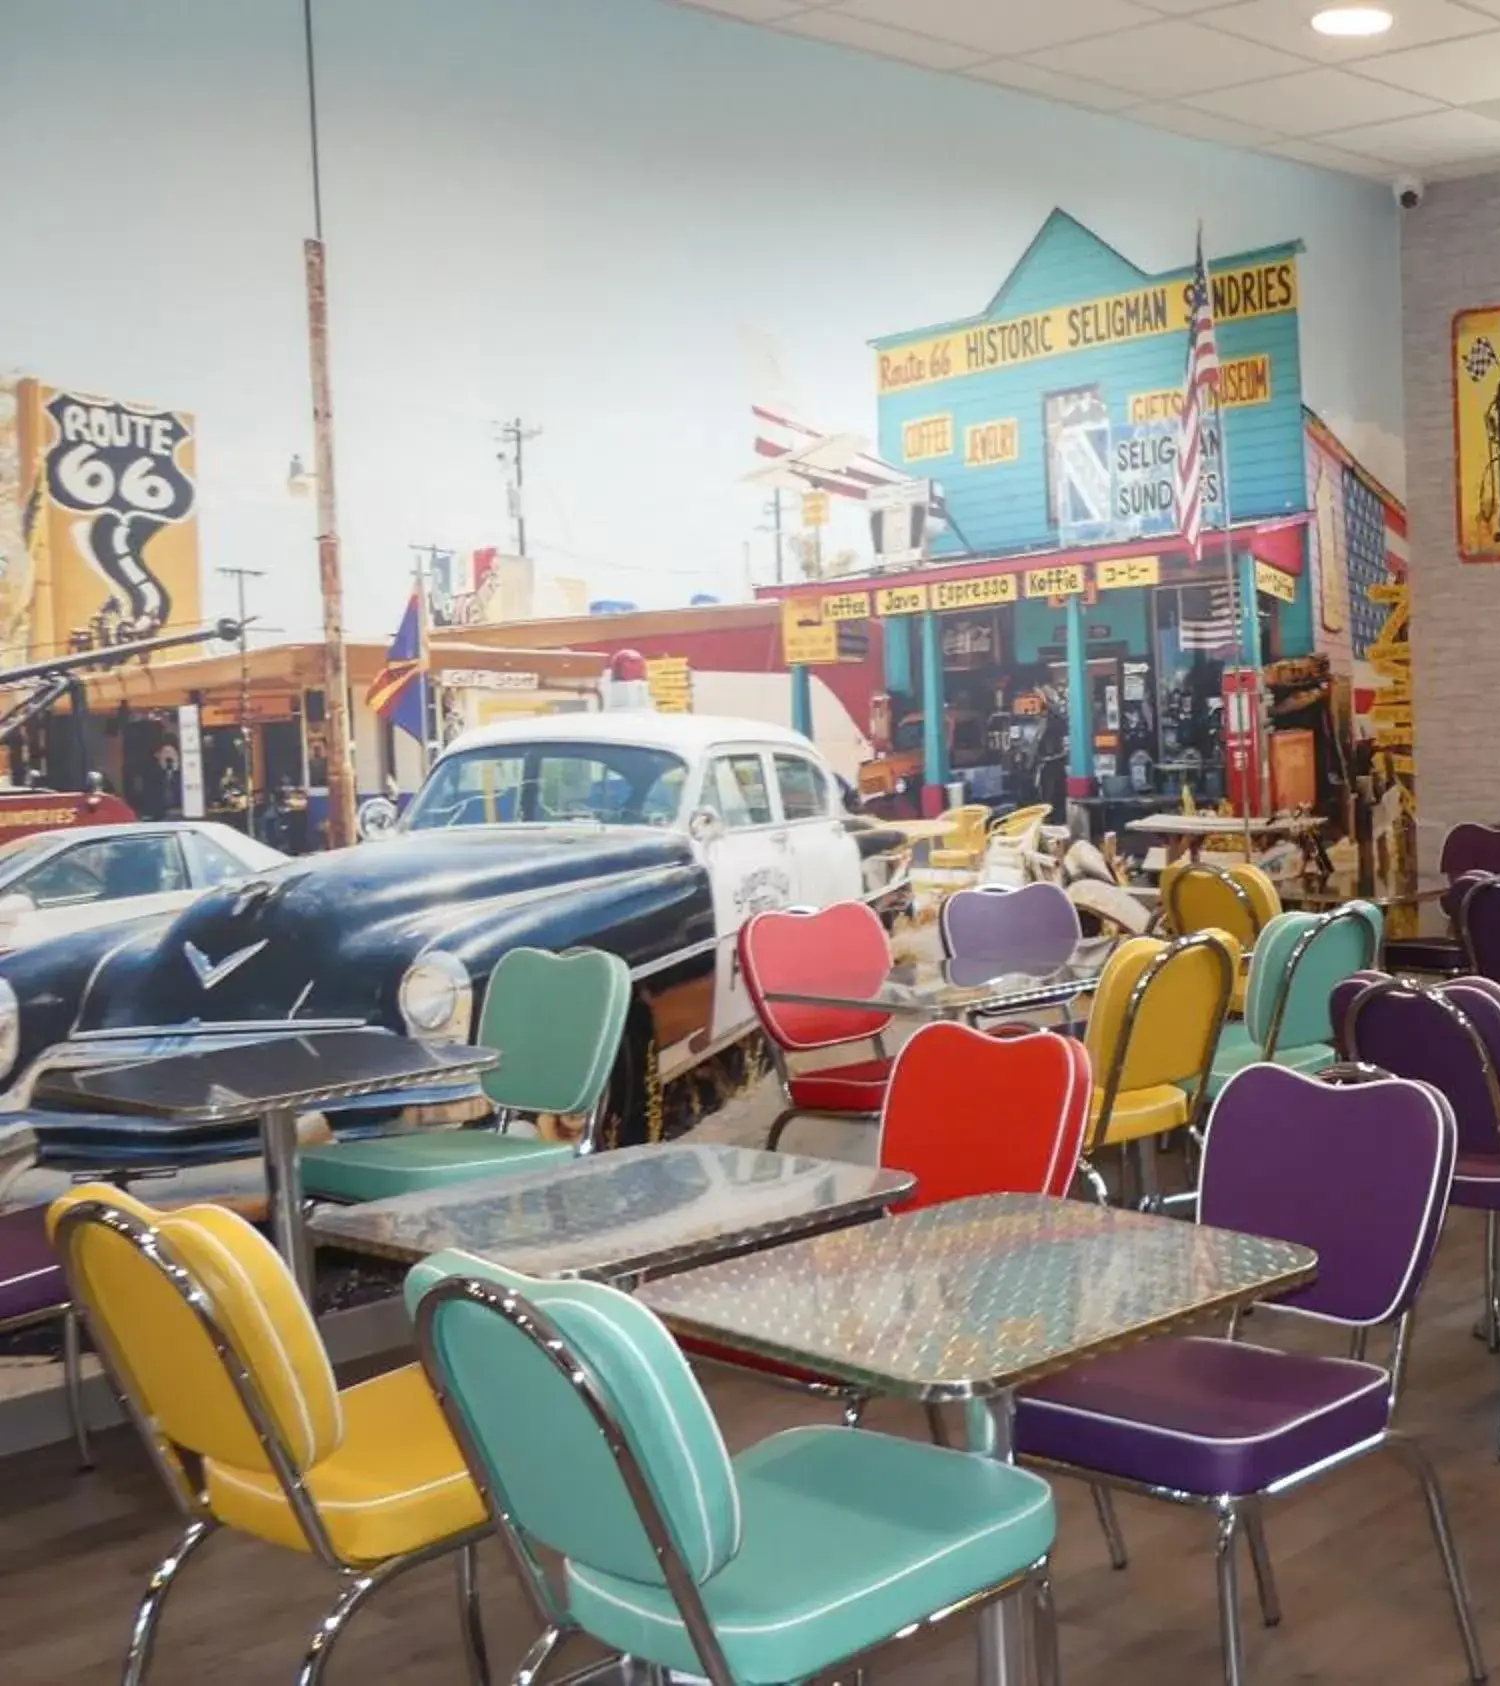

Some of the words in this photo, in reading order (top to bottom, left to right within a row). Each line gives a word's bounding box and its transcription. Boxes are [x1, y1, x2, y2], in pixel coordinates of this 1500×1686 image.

[929, 341, 951, 379] 66
[965, 315, 1053, 370] HISTORIC
[1067, 286, 1168, 348] SELIGMAN
[1183, 264, 1292, 324] SNDRIES
[62, 404, 173, 456] ROUTE
[57, 442, 176, 510] 66
[885, 591, 919, 611] Java
[1029, 568, 1078, 594] Koffie
